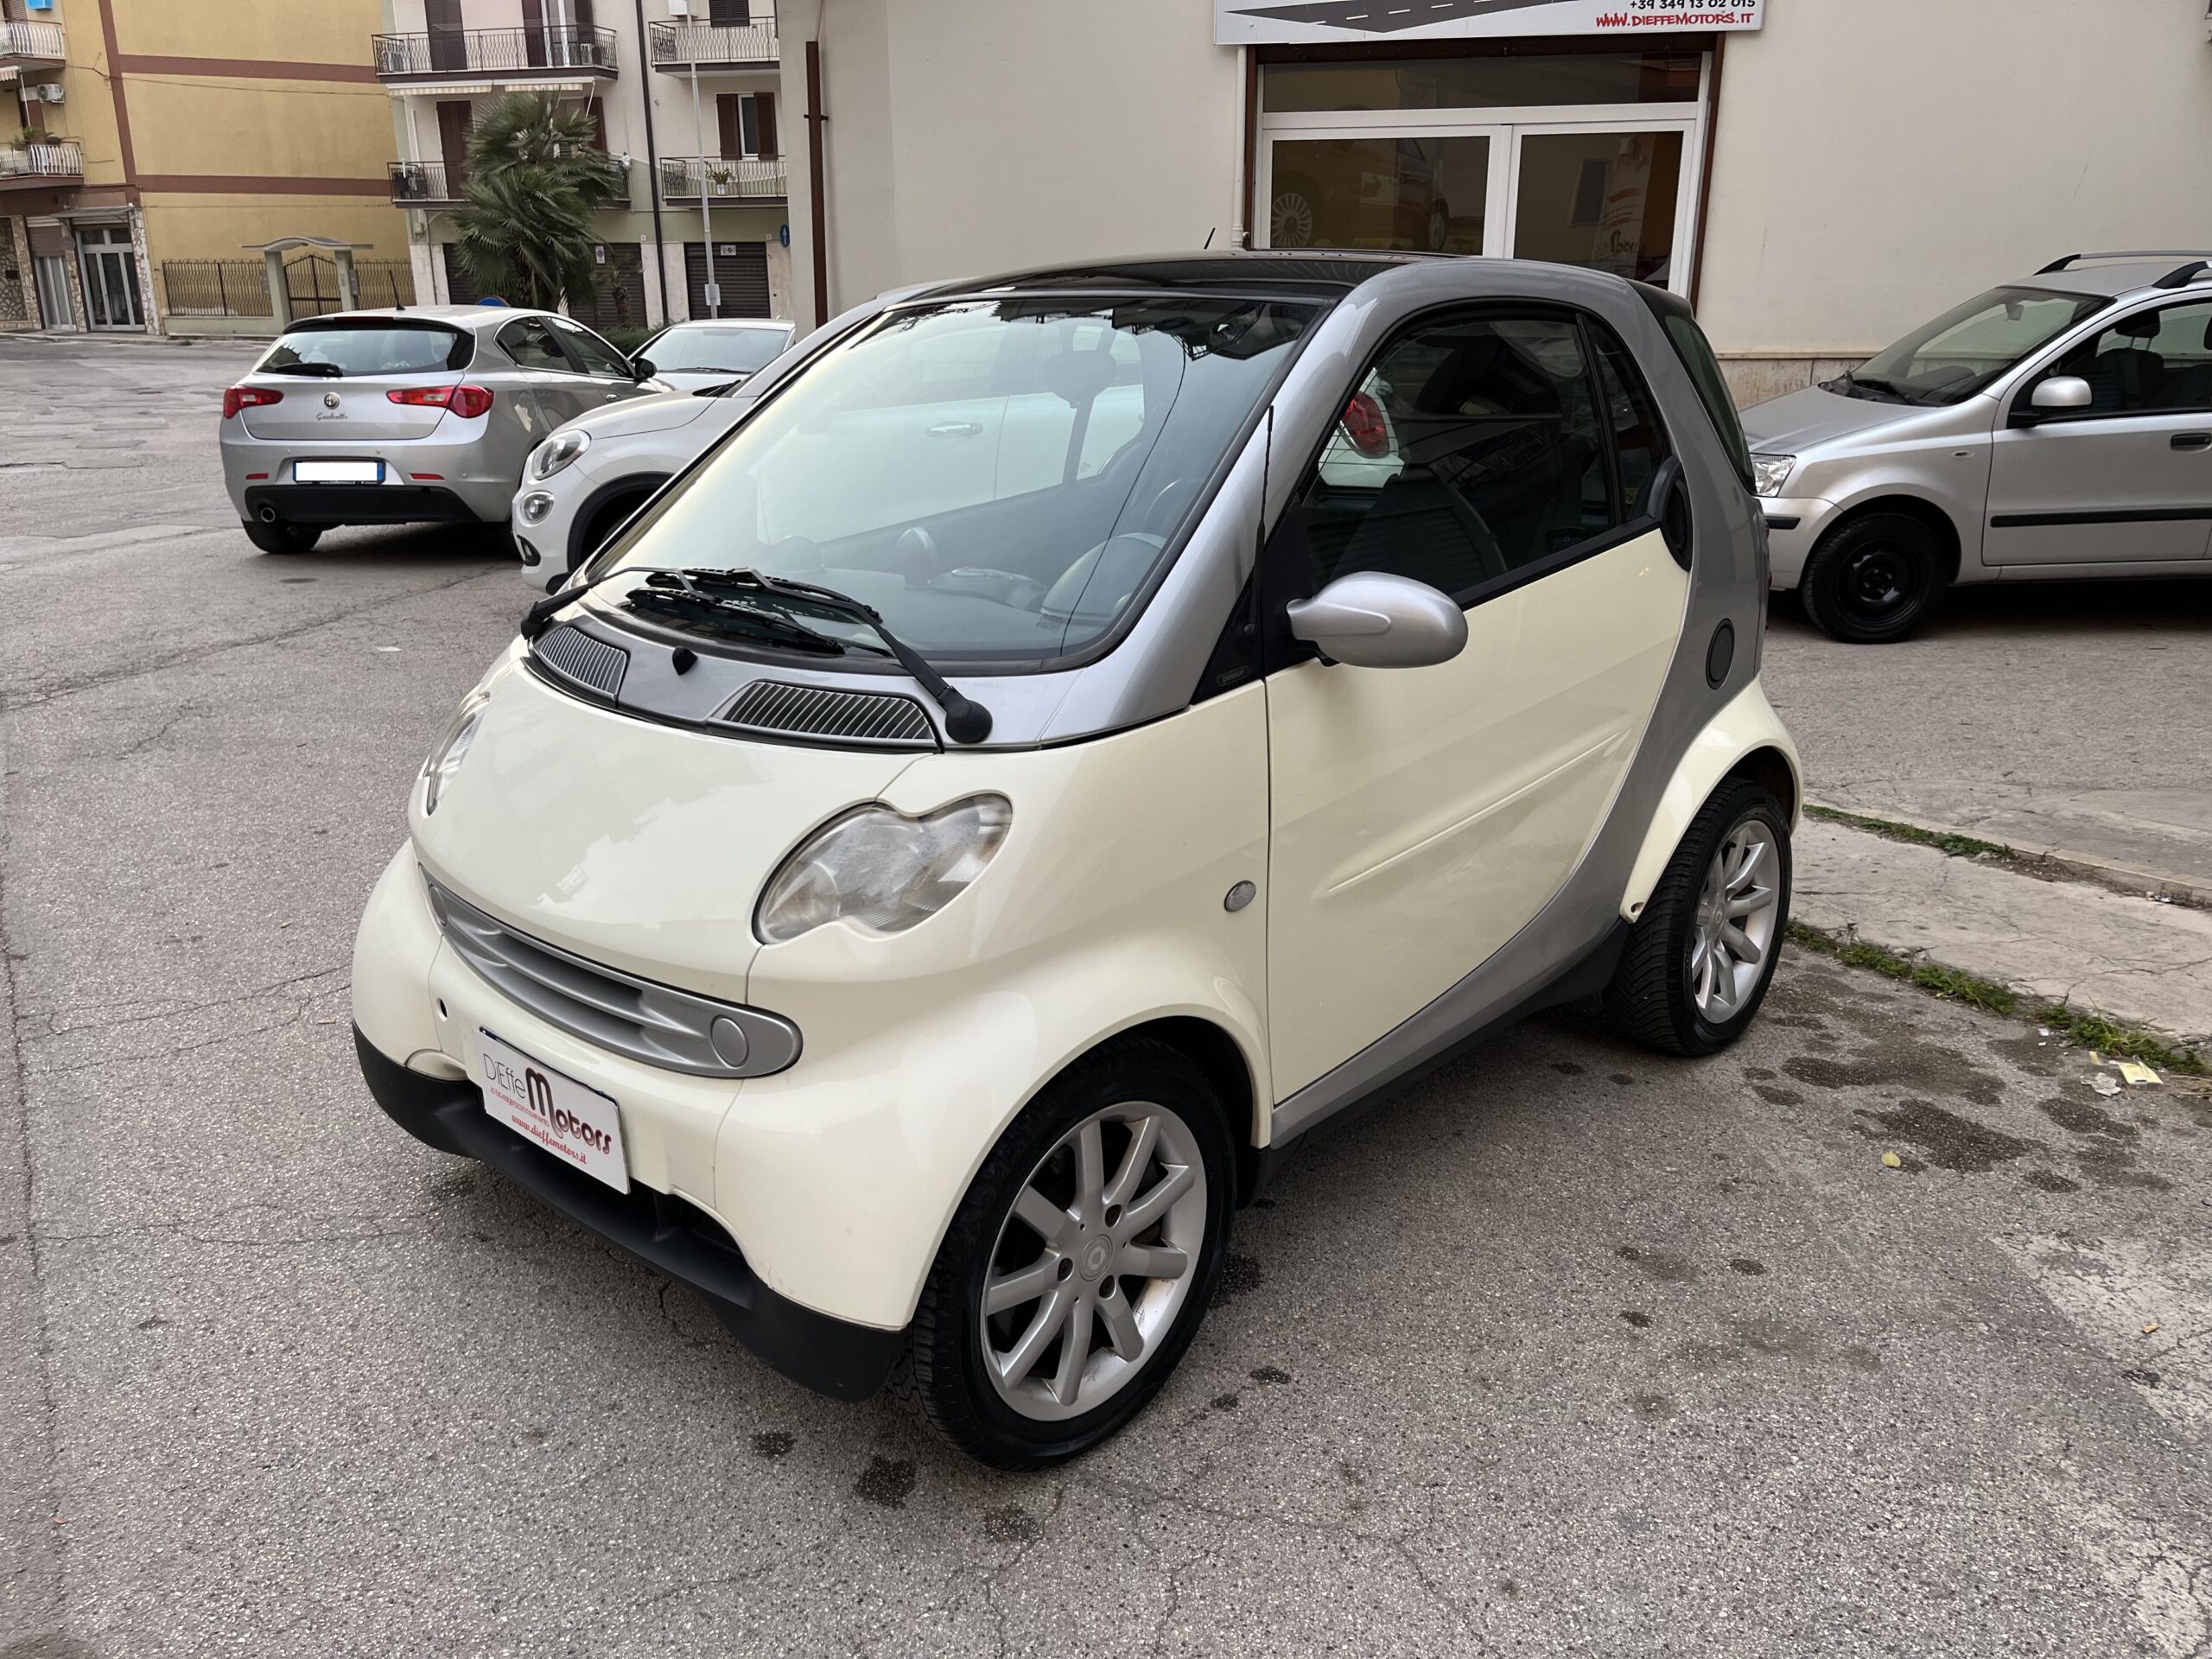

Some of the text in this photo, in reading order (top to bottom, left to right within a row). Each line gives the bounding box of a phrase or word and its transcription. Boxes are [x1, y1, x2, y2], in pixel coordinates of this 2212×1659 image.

[1630, 0, 1655, 10] +39
[1659, 0, 1685, 9] 349
[1689, 0, 1703, 9] 13
[483, 1053, 526, 1099] DiEffe
[512, 1115, 588, 1165] www.dieffemotors.it
